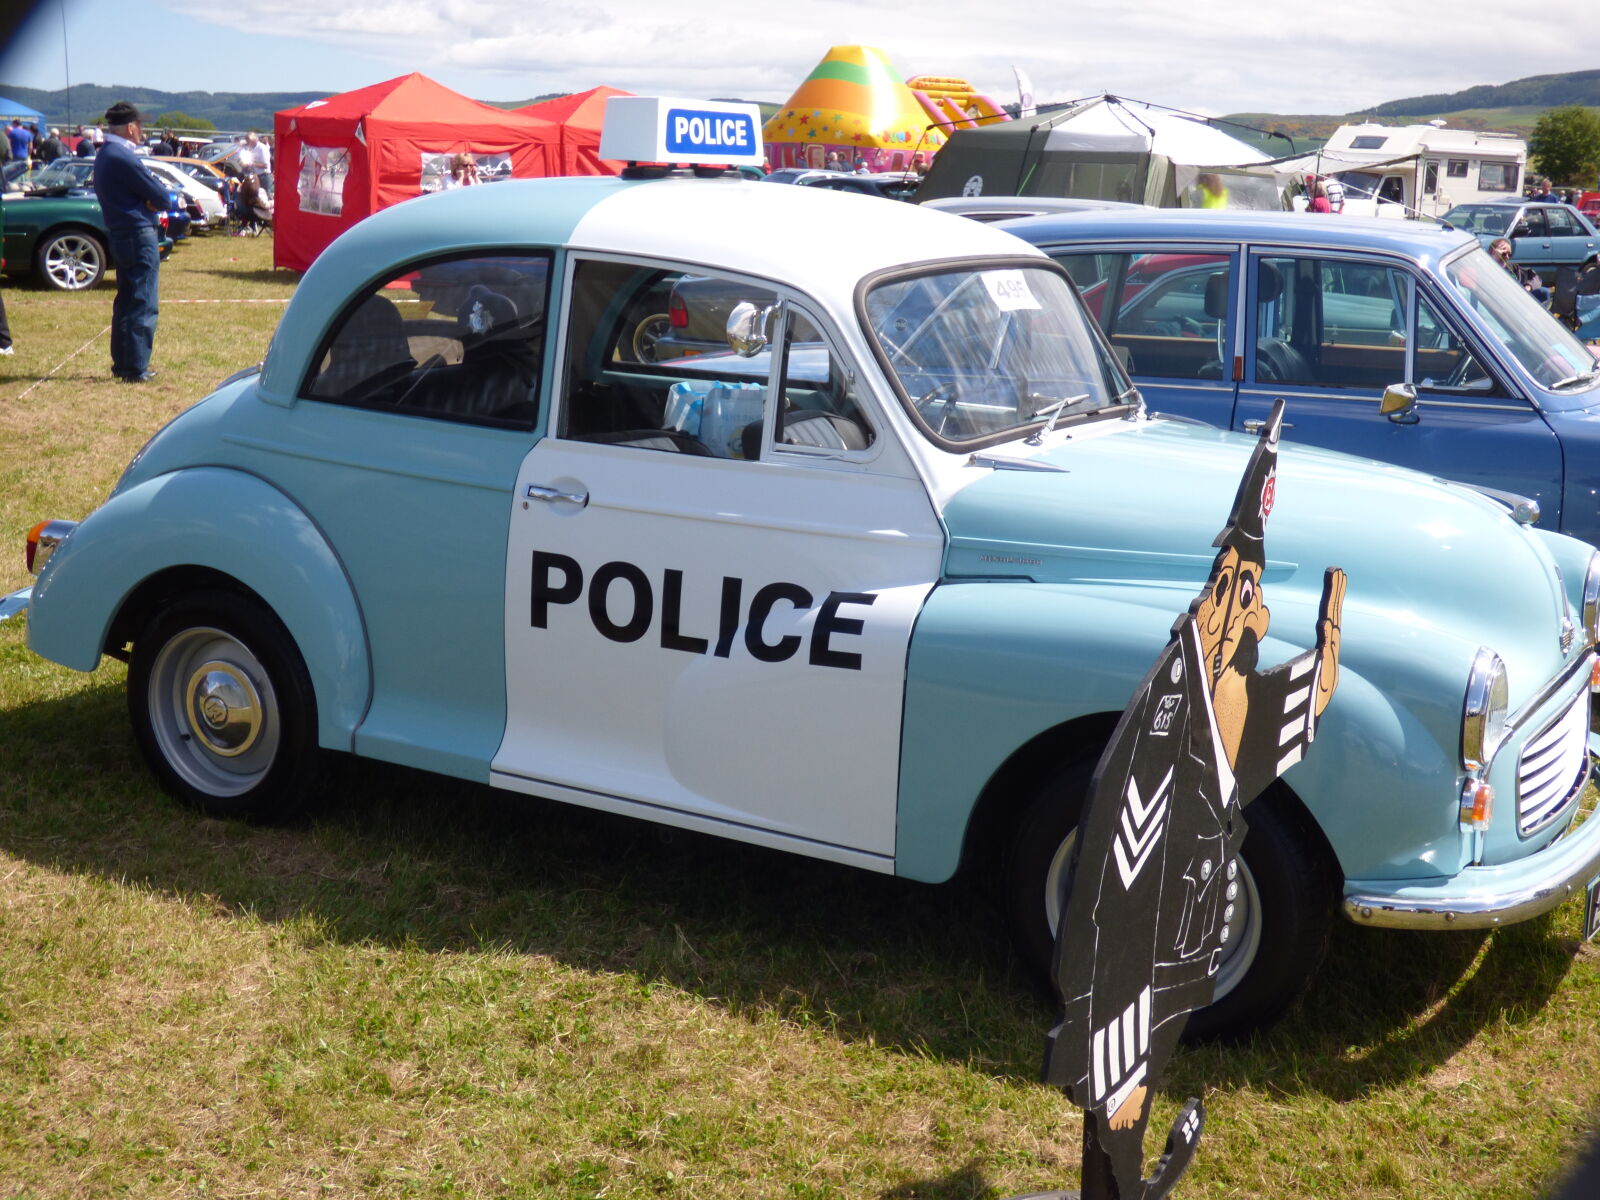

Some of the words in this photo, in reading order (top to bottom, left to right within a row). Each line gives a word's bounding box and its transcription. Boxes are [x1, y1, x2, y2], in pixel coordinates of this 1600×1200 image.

[675, 116, 748, 146] POLICE
[530, 549, 879, 671] POLICE
[1153, 710, 1173, 731] 615
